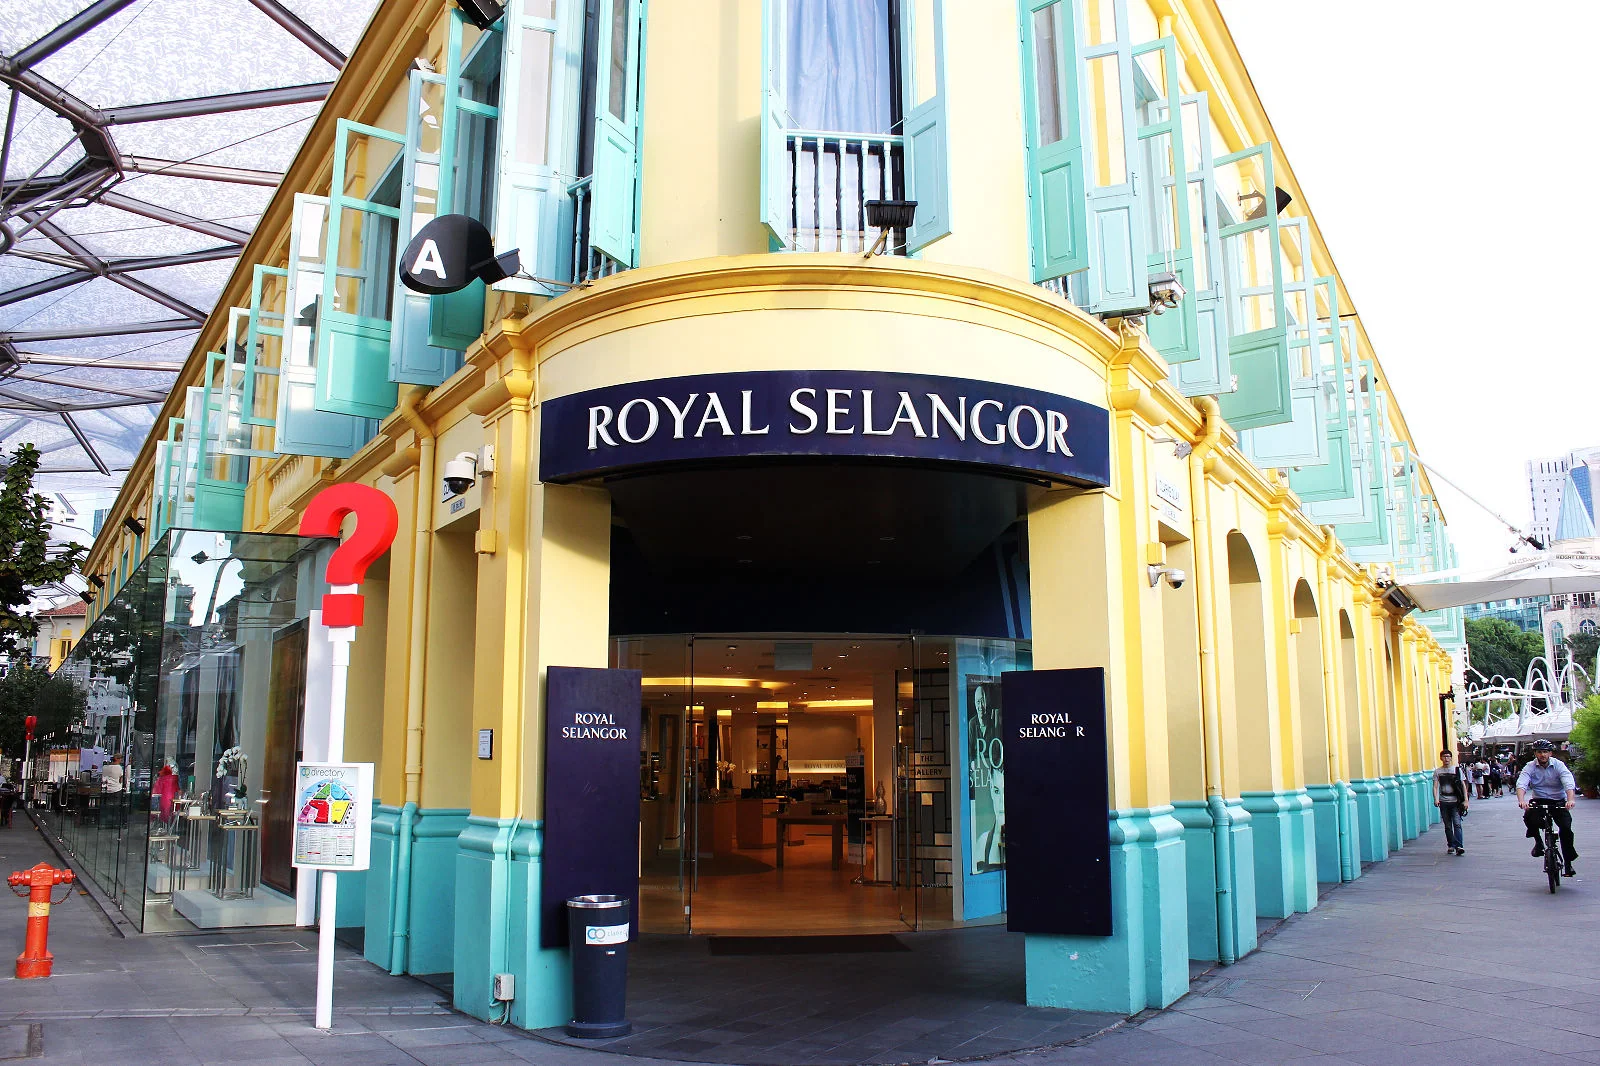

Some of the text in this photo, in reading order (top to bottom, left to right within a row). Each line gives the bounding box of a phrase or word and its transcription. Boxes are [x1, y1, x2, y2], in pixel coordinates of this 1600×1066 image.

[411, 239, 447, 280] A
[588, 388, 1075, 458] ROYAL SELANGOR
[575, 712, 616, 725] ROYAL
[1031, 712, 1072, 725] ROYAL
[562, 726, 628, 740] SELANGOR
[311, 767, 346, 778] directory
